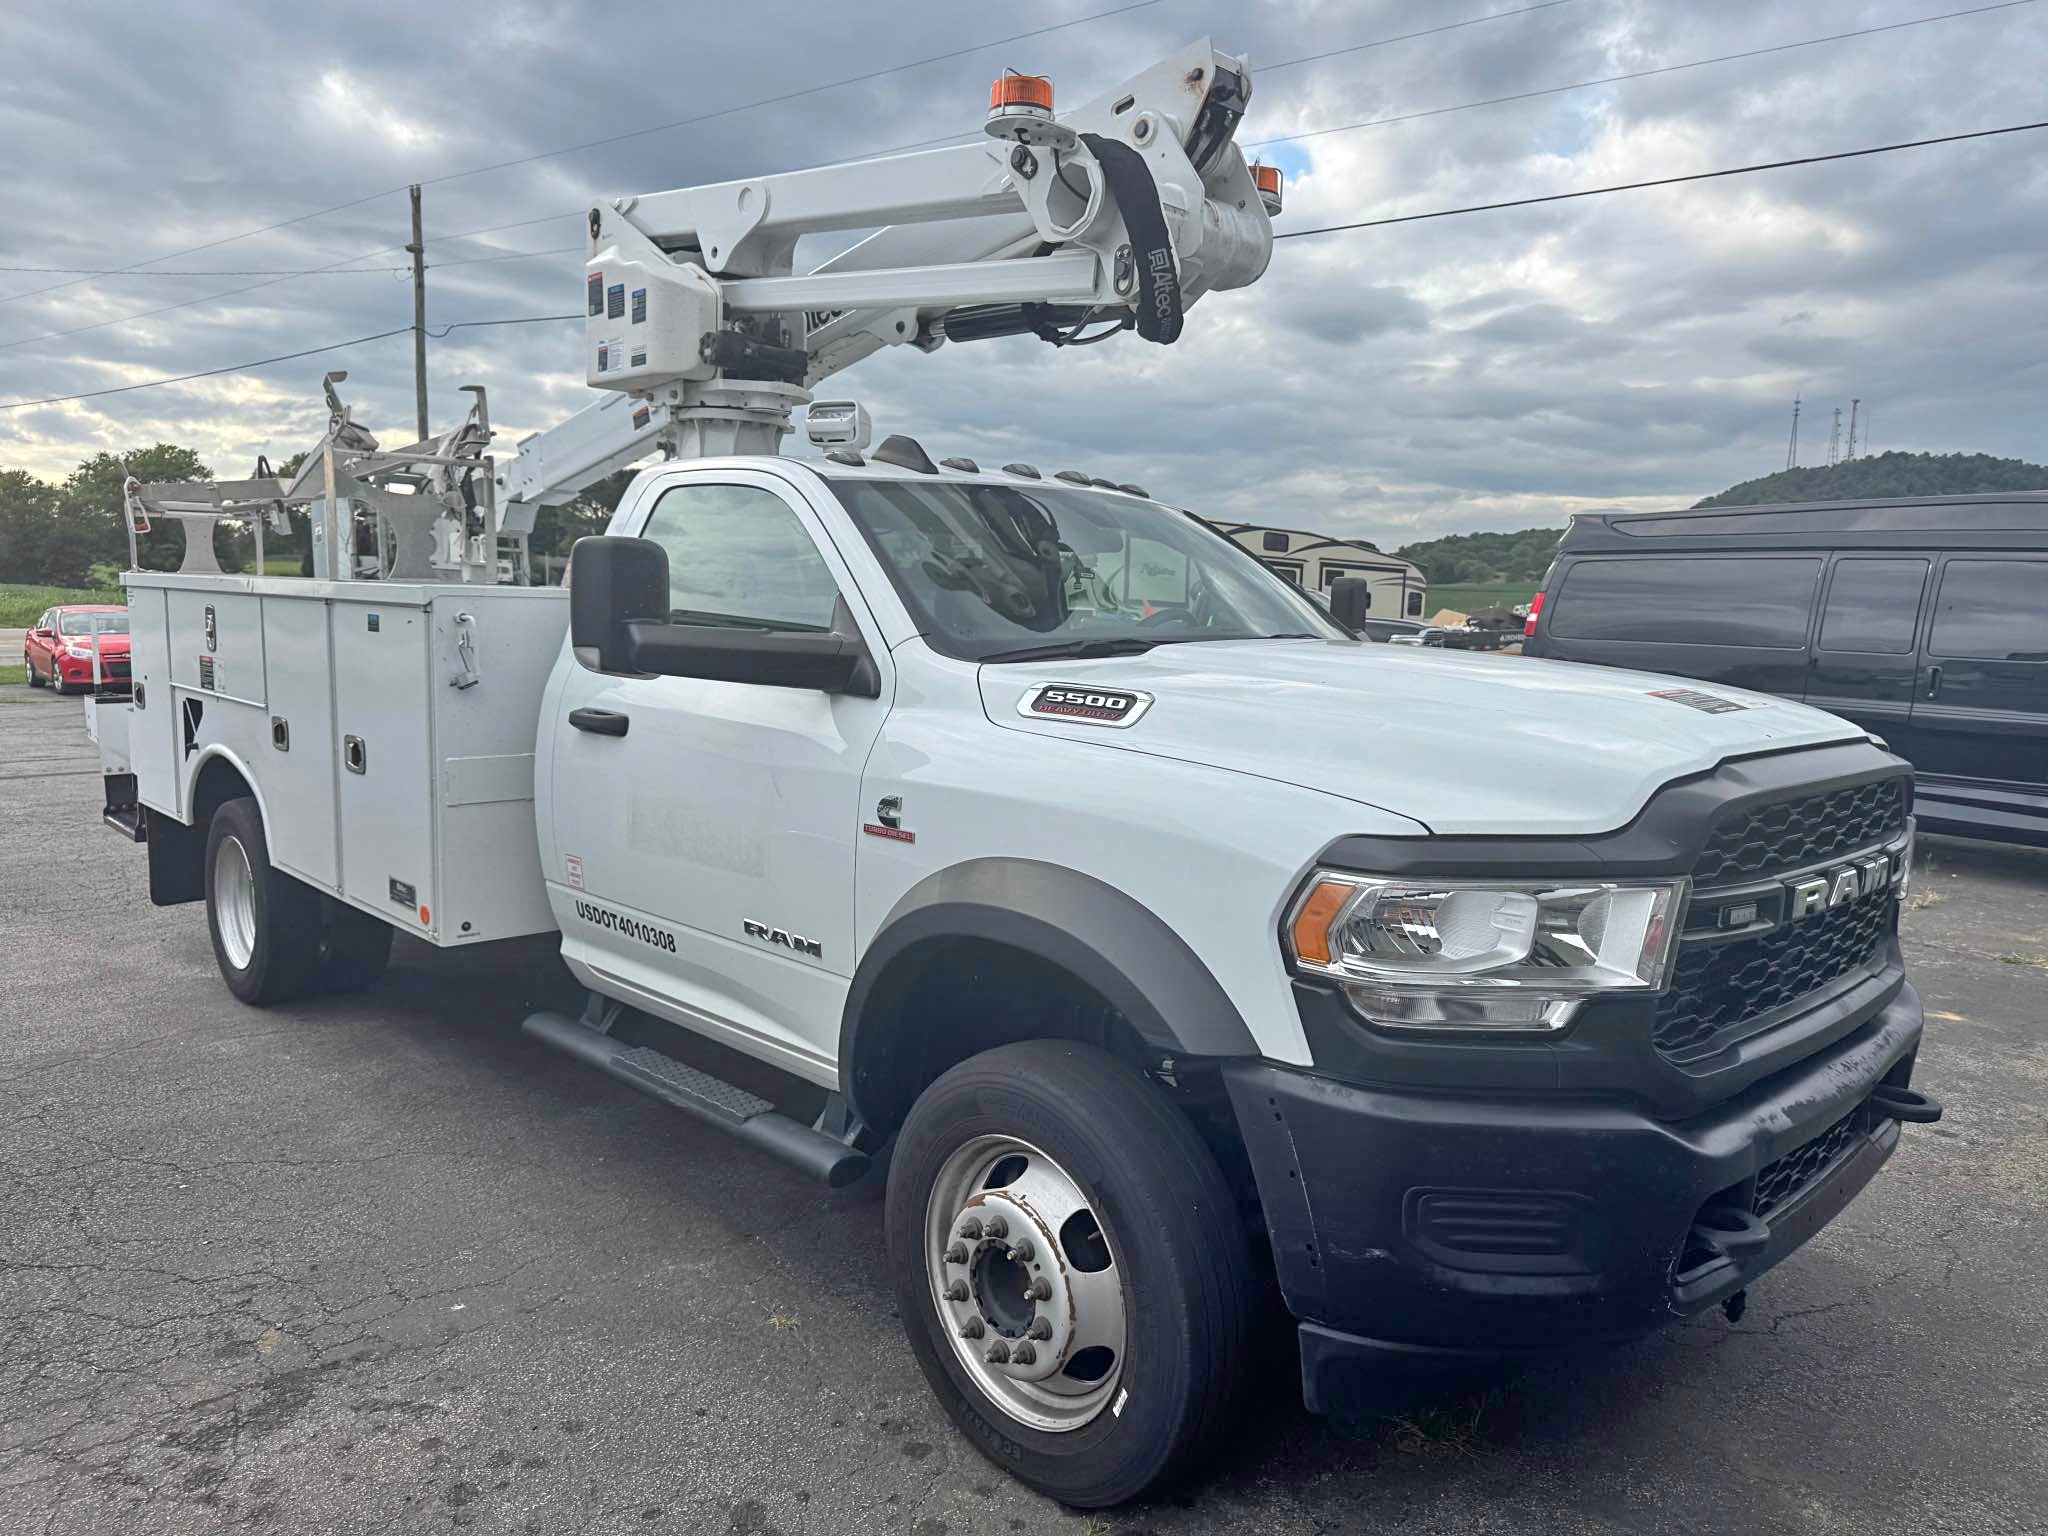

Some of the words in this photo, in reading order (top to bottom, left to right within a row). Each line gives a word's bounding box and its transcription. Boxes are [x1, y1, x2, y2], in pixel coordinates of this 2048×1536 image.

[1151, 272, 1174, 318] Altec
[1046, 690, 1126, 709] 5500
[1788, 855, 1889, 922] RAM
[576, 900, 676, 952] USDOT4010308
[744, 918, 822, 959] RAM
